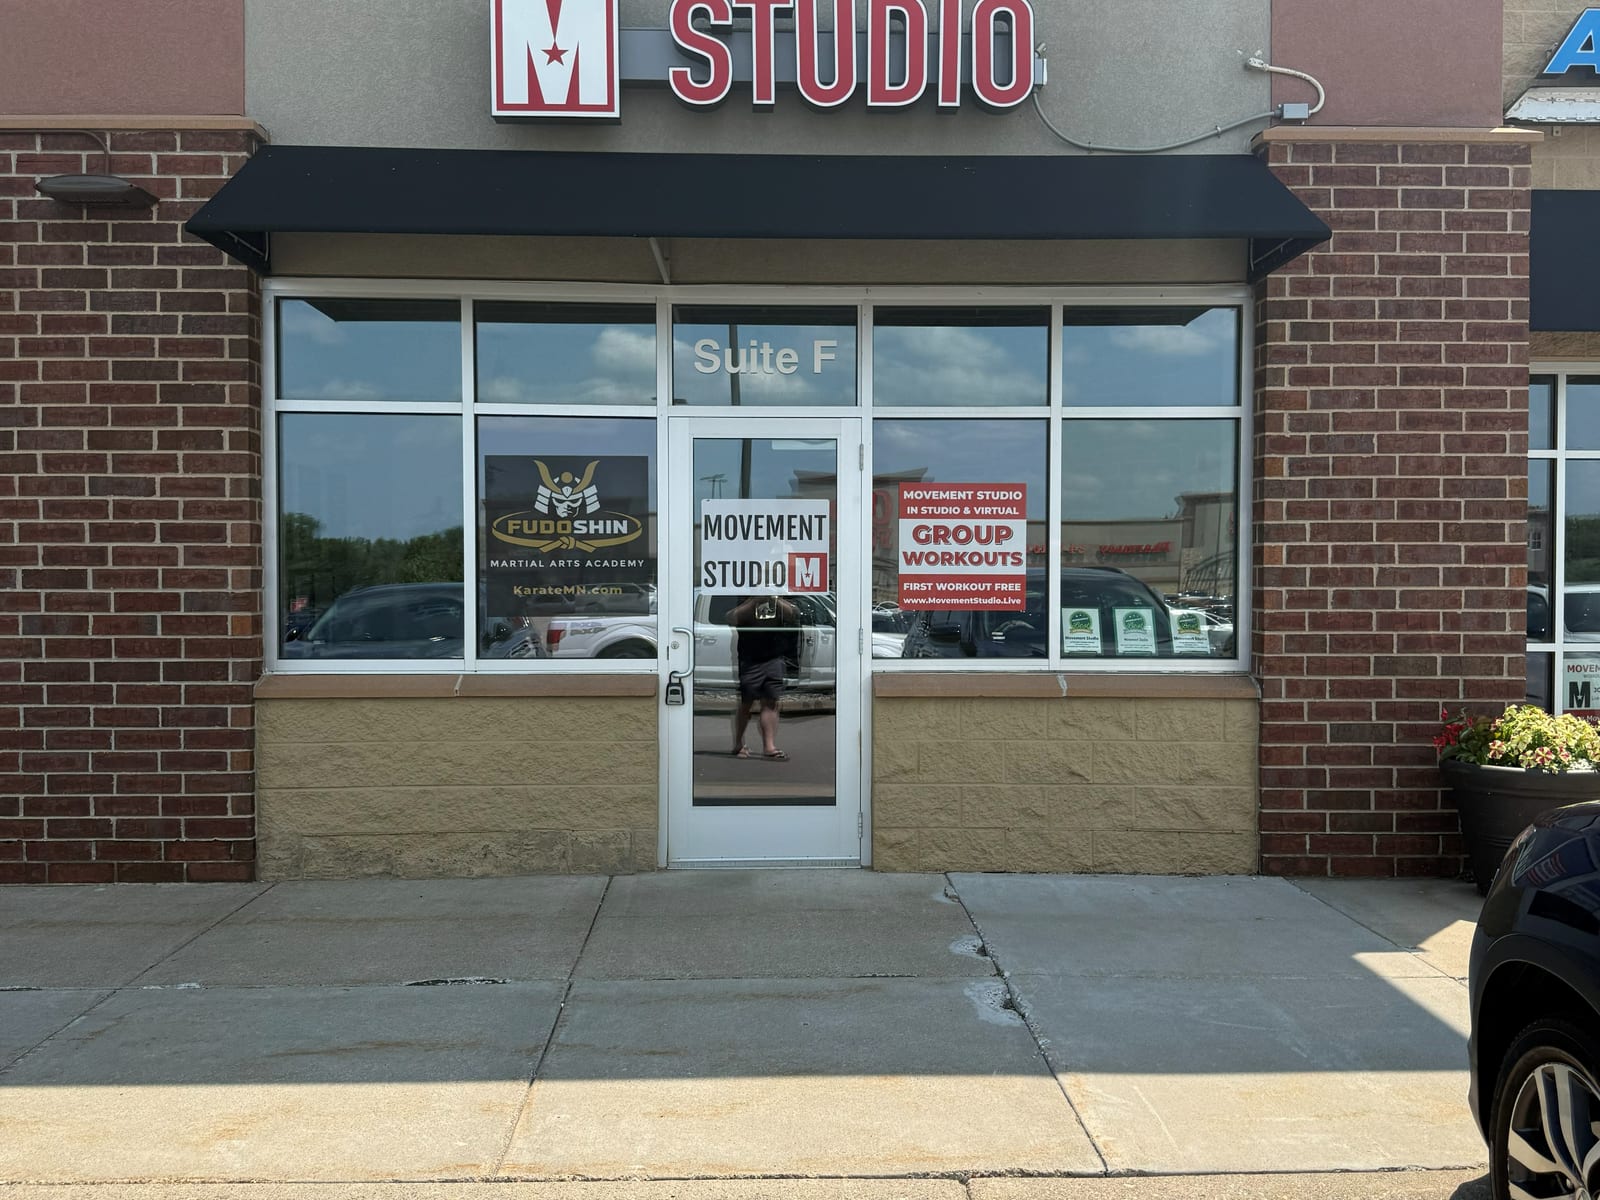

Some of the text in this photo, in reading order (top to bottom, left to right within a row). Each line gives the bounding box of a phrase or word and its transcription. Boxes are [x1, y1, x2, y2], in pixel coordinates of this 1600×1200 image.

[668, 0, 1036, 107] STUDIO
[694, 338, 838, 374] Suite F
[903, 490, 1022, 500] MOVEMENT STUDIO
[906, 506, 1019, 515] IN STUDIO & VIRTUAL
[507, 519, 628, 535] FUDOSHIN
[703, 514, 827, 541] MOVEMENT
[912, 525, 1013, 545] GROUP
[490, 559, 645, 568] MARTIAL ARTS ACADEMY
[902, 551, 1024, 567] WORKOUTS
[703, 557, 821, 588] STUDIO M
[513, 585, 623, 596] KarateMN.com
[903, 582, 1021, 591] FIRST WORKOUT FREE
[903, 597, 1021, 605] www.MovementStudio.Live
